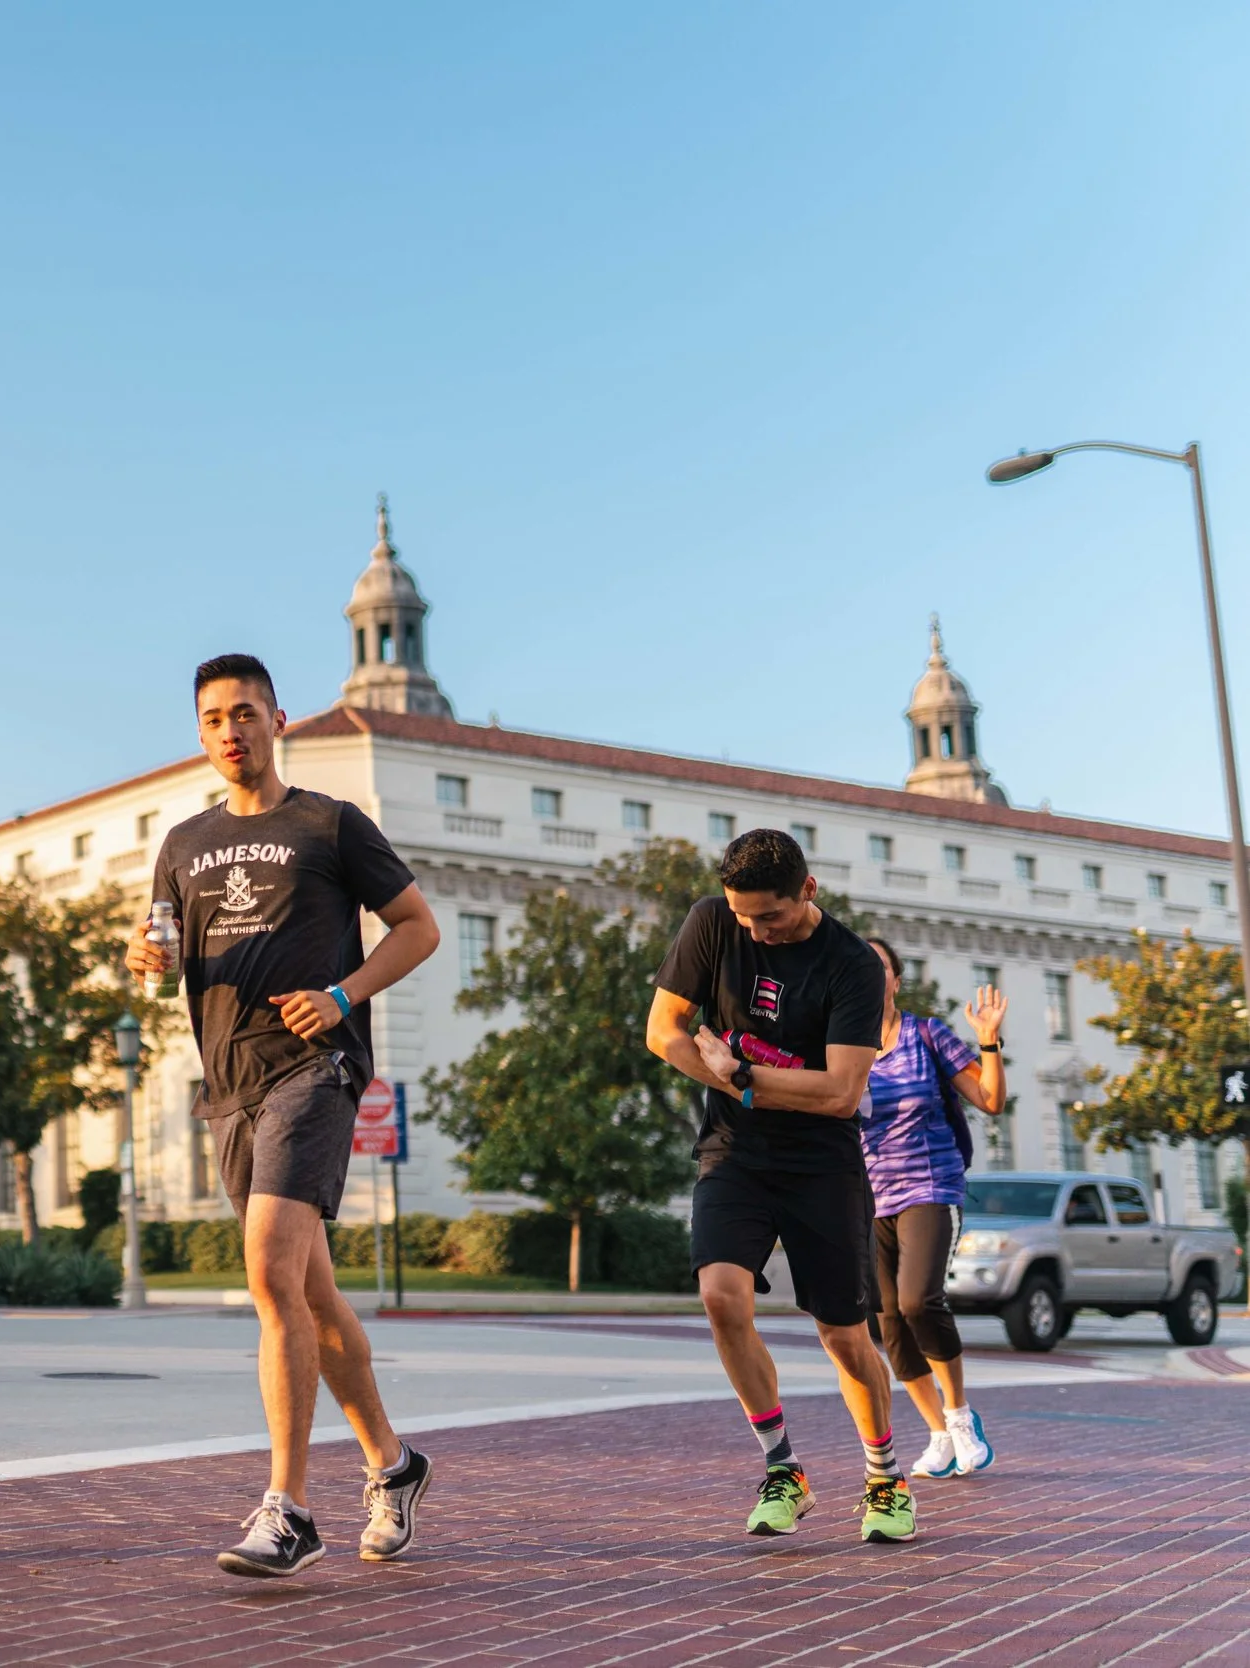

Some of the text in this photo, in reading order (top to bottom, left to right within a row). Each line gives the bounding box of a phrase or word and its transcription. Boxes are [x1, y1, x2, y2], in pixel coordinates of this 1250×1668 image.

[189, 844, 293, 877] JAMESON
[207, 924, 273, 936] IRISH WHISKEY
